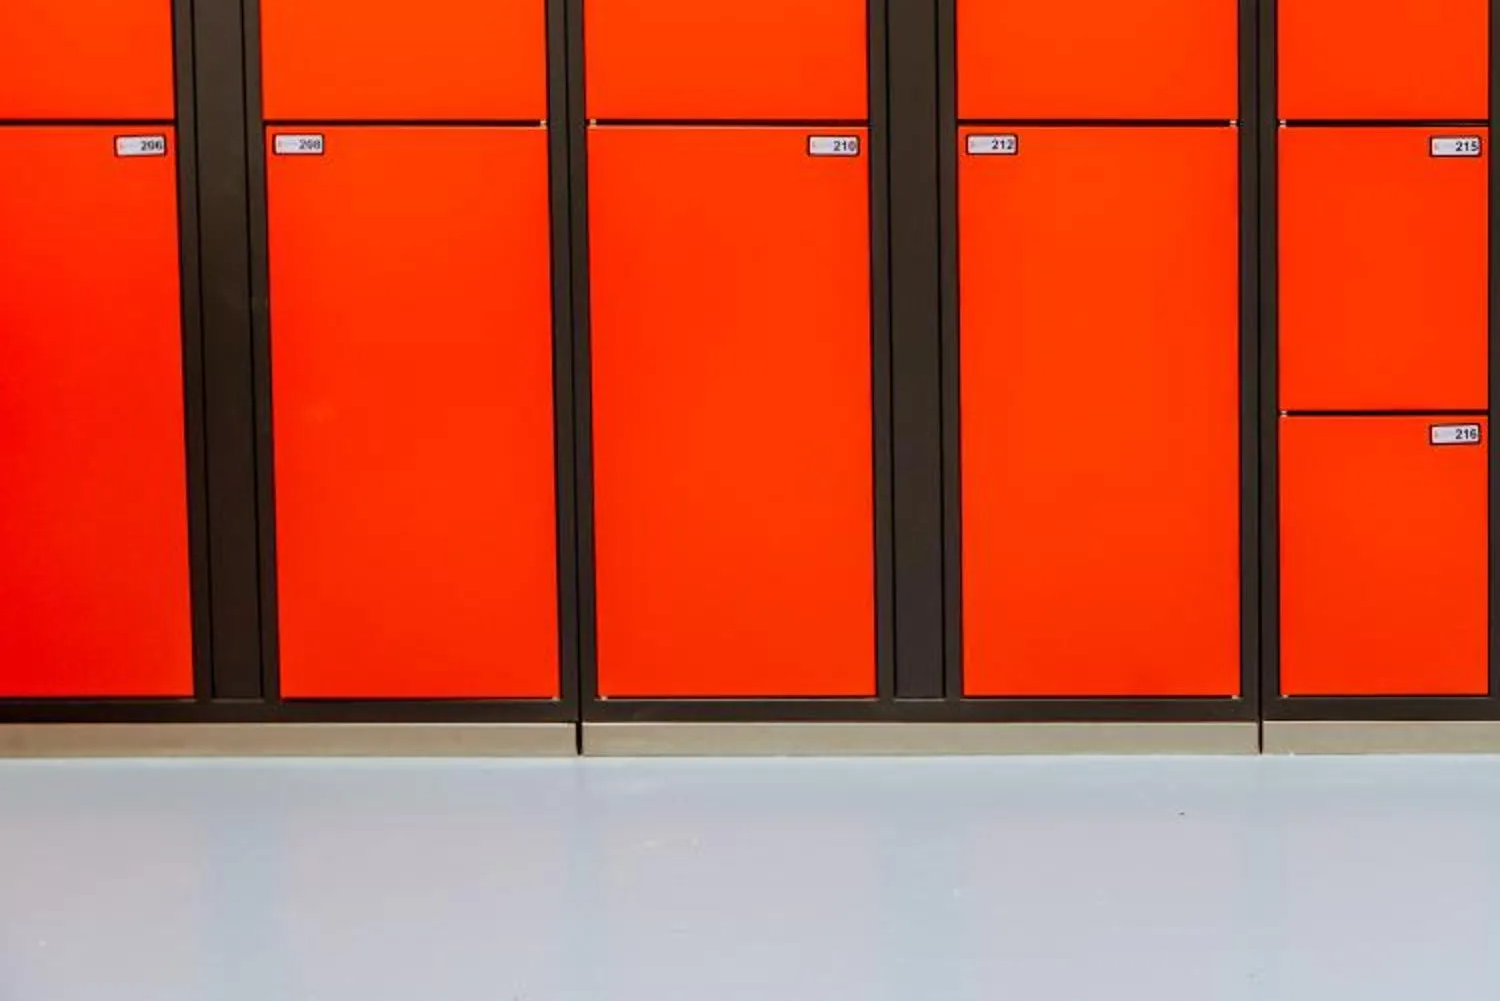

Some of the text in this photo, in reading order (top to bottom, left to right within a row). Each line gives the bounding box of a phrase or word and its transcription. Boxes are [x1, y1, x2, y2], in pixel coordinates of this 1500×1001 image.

[141, 140, 163, 151] 206
[299, 140, 321, 150] 208
[833, 141, 856, 151] 210
[992, 140, 1013, 150] 212
[1455, 141, 1478, 152] 215
[1455, 429, 1476, 440] 216
